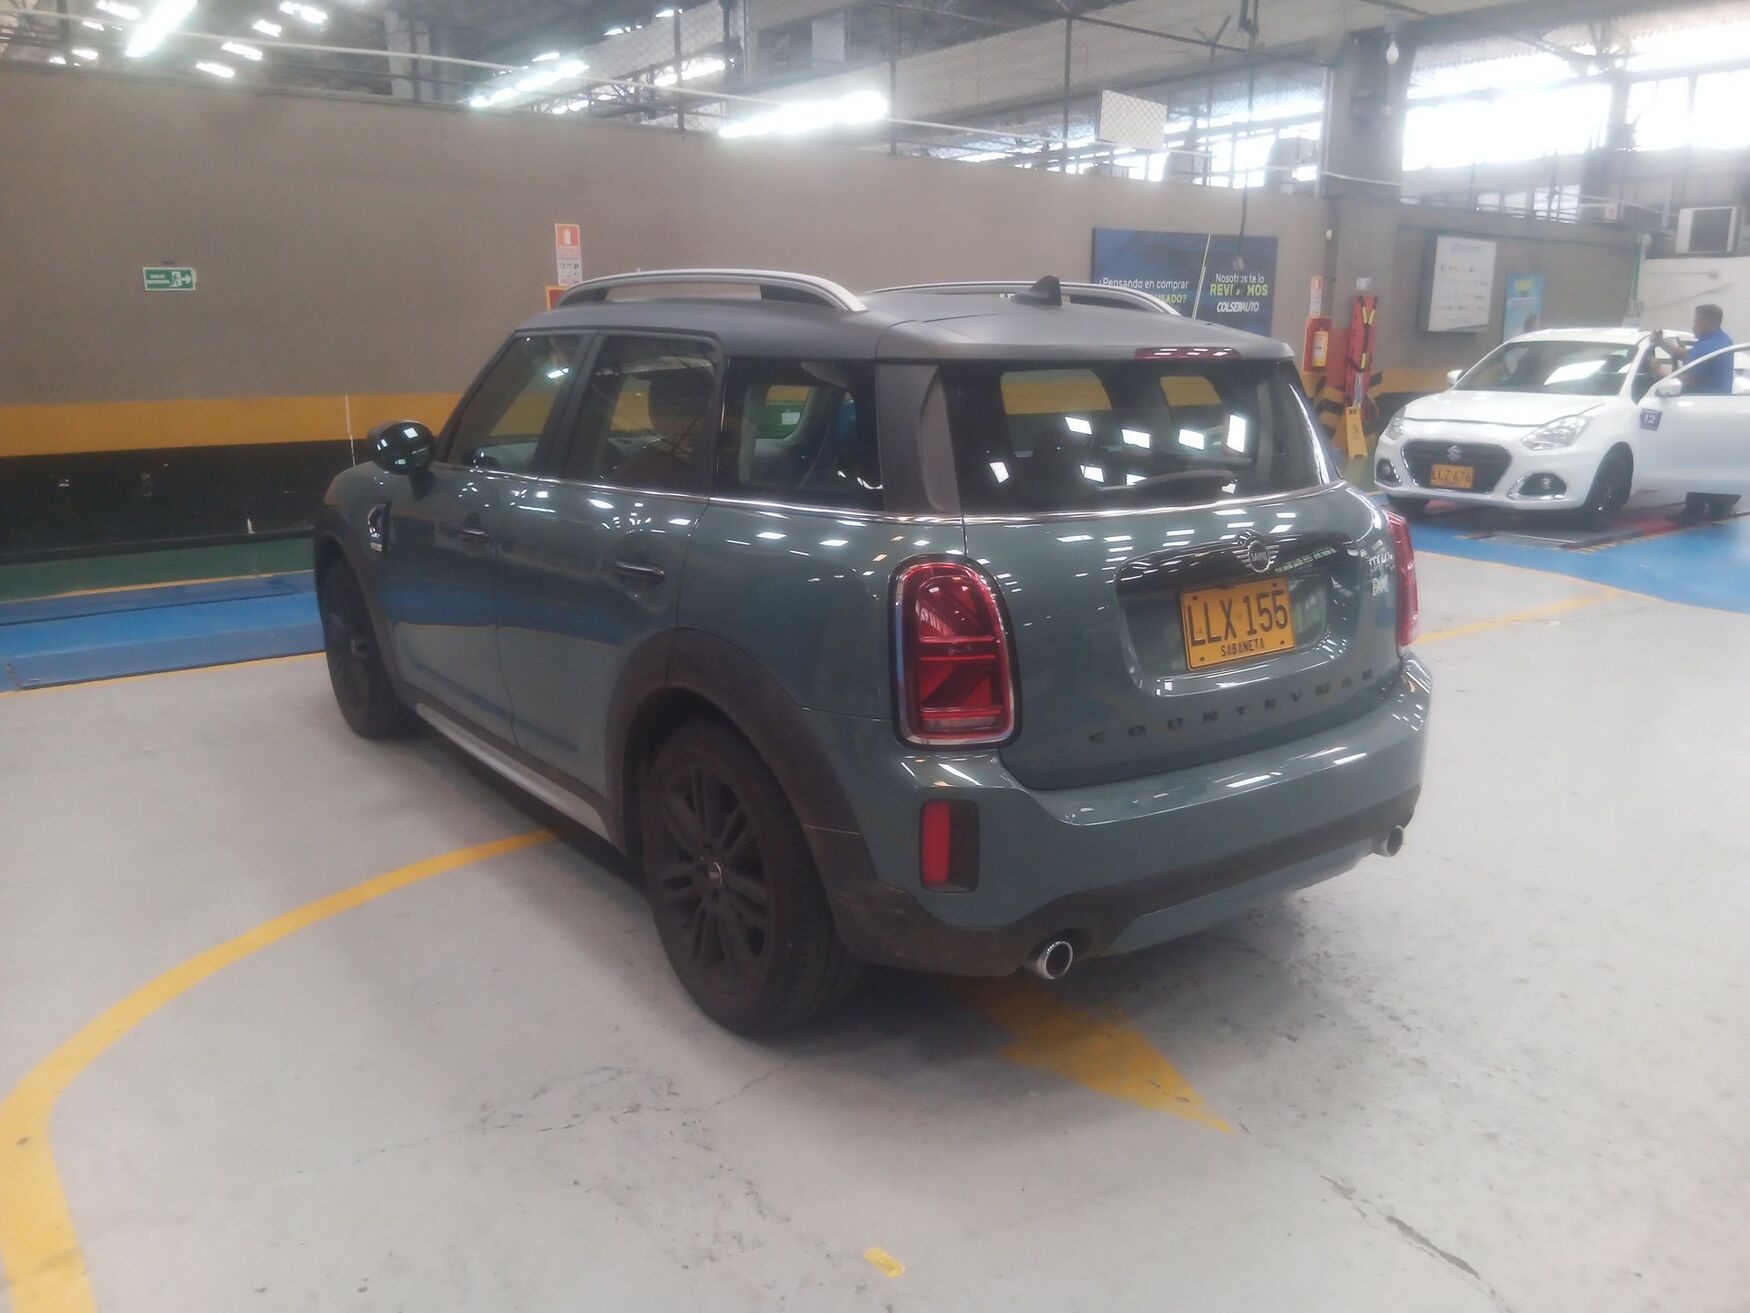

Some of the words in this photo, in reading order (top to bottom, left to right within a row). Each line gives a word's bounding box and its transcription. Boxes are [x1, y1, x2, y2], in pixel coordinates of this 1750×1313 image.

[1249, 274, 1257, 283] te
[1258, 274, 1265, 284] lo
[1144, 280, 1155, 289] en
[1156, 280, 1189, 291] comprar
[1210, 283, 1268, 296] REVIMOS
[1644, 413, 1656, 424] 12
[1251, 551, 1268, 562] MINI
[1186, 597, 1238, 647] LLX
[1245, 589, 1289, 636] 155
[1220, 638, 1265, 657] SABANETA
[1089, 669, 1373, 743] COUNTRYMAN
